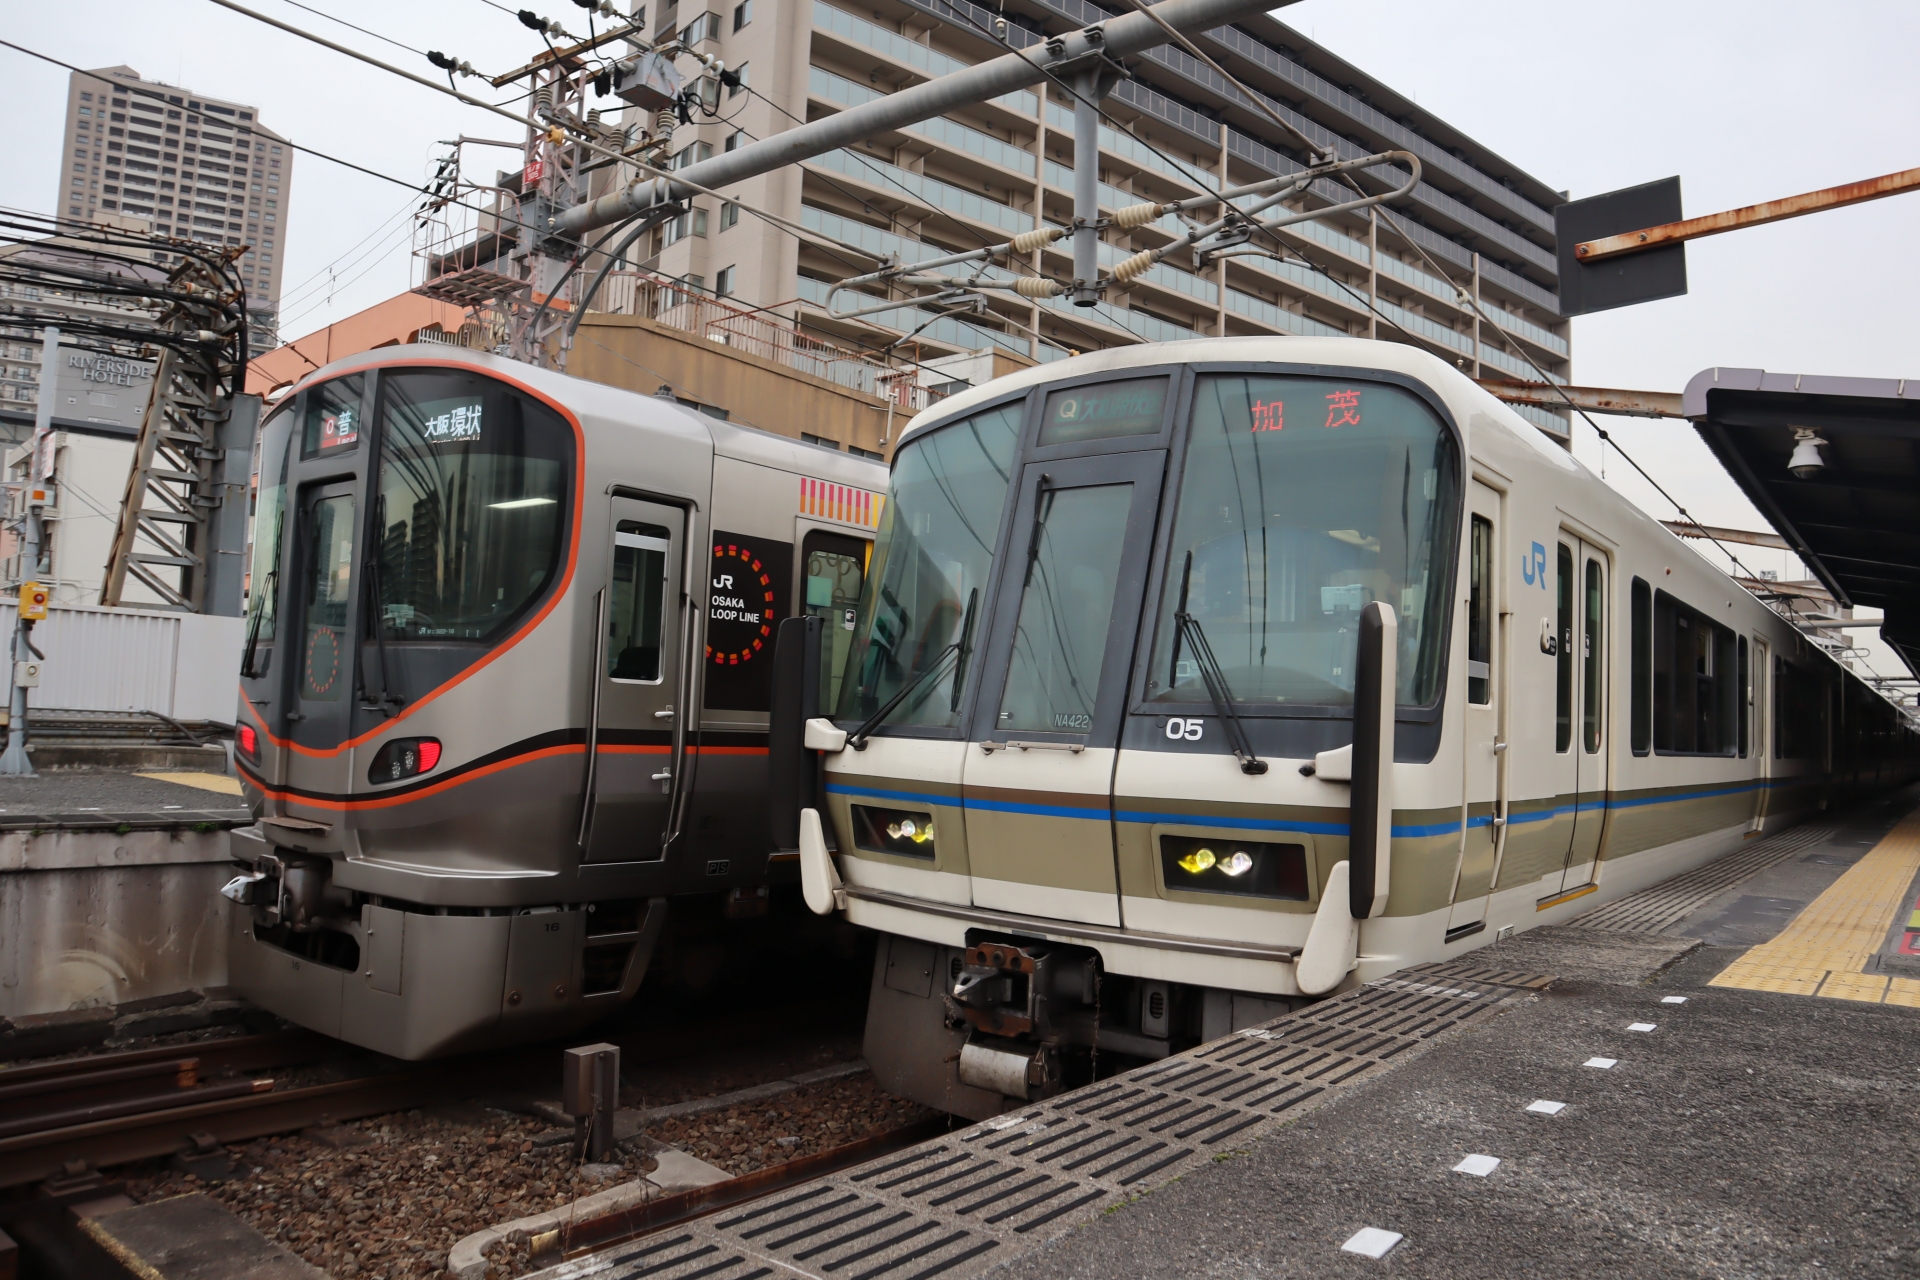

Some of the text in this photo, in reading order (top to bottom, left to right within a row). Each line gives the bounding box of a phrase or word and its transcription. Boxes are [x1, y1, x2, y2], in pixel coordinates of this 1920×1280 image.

[69, 355, 151, 378] RIVERSIDE
[83, 369, 134, 387] HOTEL
[1059, 399, 1077, 419] Q
[1251, 389, 1361, 432] 加茂
[338, 410, 359, 437] 普
[424, 404, 482, 438] 大阪環状
[1522, 540, 1546, 590] JR
[712, 574, 734, 590] JR
[711, 595, 745, 609] OSAKA
[711, 608, 760, 624] LOOP LINE
[1053, 713, 1090, 729] NA422
[1165, 717, 1204, 741] 05
[545, 922, 560, 932] 16
